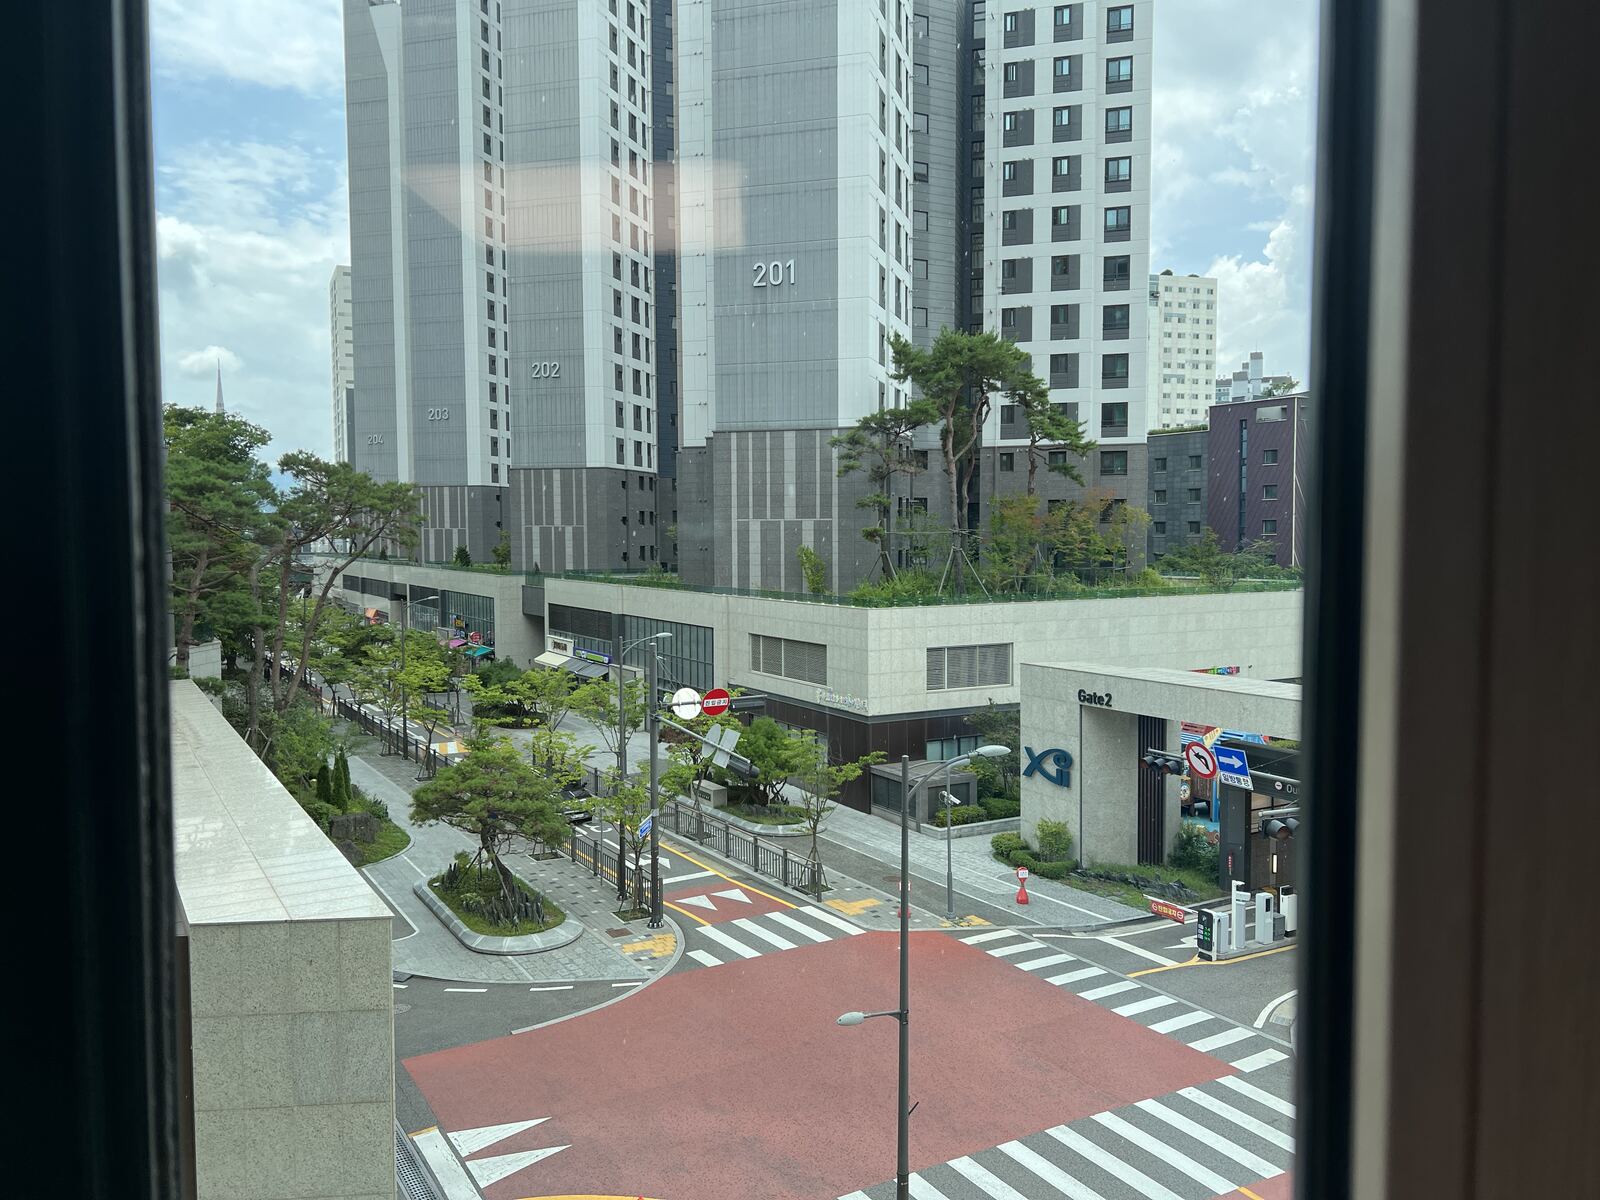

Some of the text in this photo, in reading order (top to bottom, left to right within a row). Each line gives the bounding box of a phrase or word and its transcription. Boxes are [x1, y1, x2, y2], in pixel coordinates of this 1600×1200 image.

[752, 259, 795, 287] 201
[531, 361, 560, 378] 202
[427, 407, 449, 420] 203
[367, 434, 384, 445] 204
[1077, 688, 1113, 708] Gate2
[1222, 773, 1250, 787] 일방통행
[1286, 784, 1300, 795] Ou
